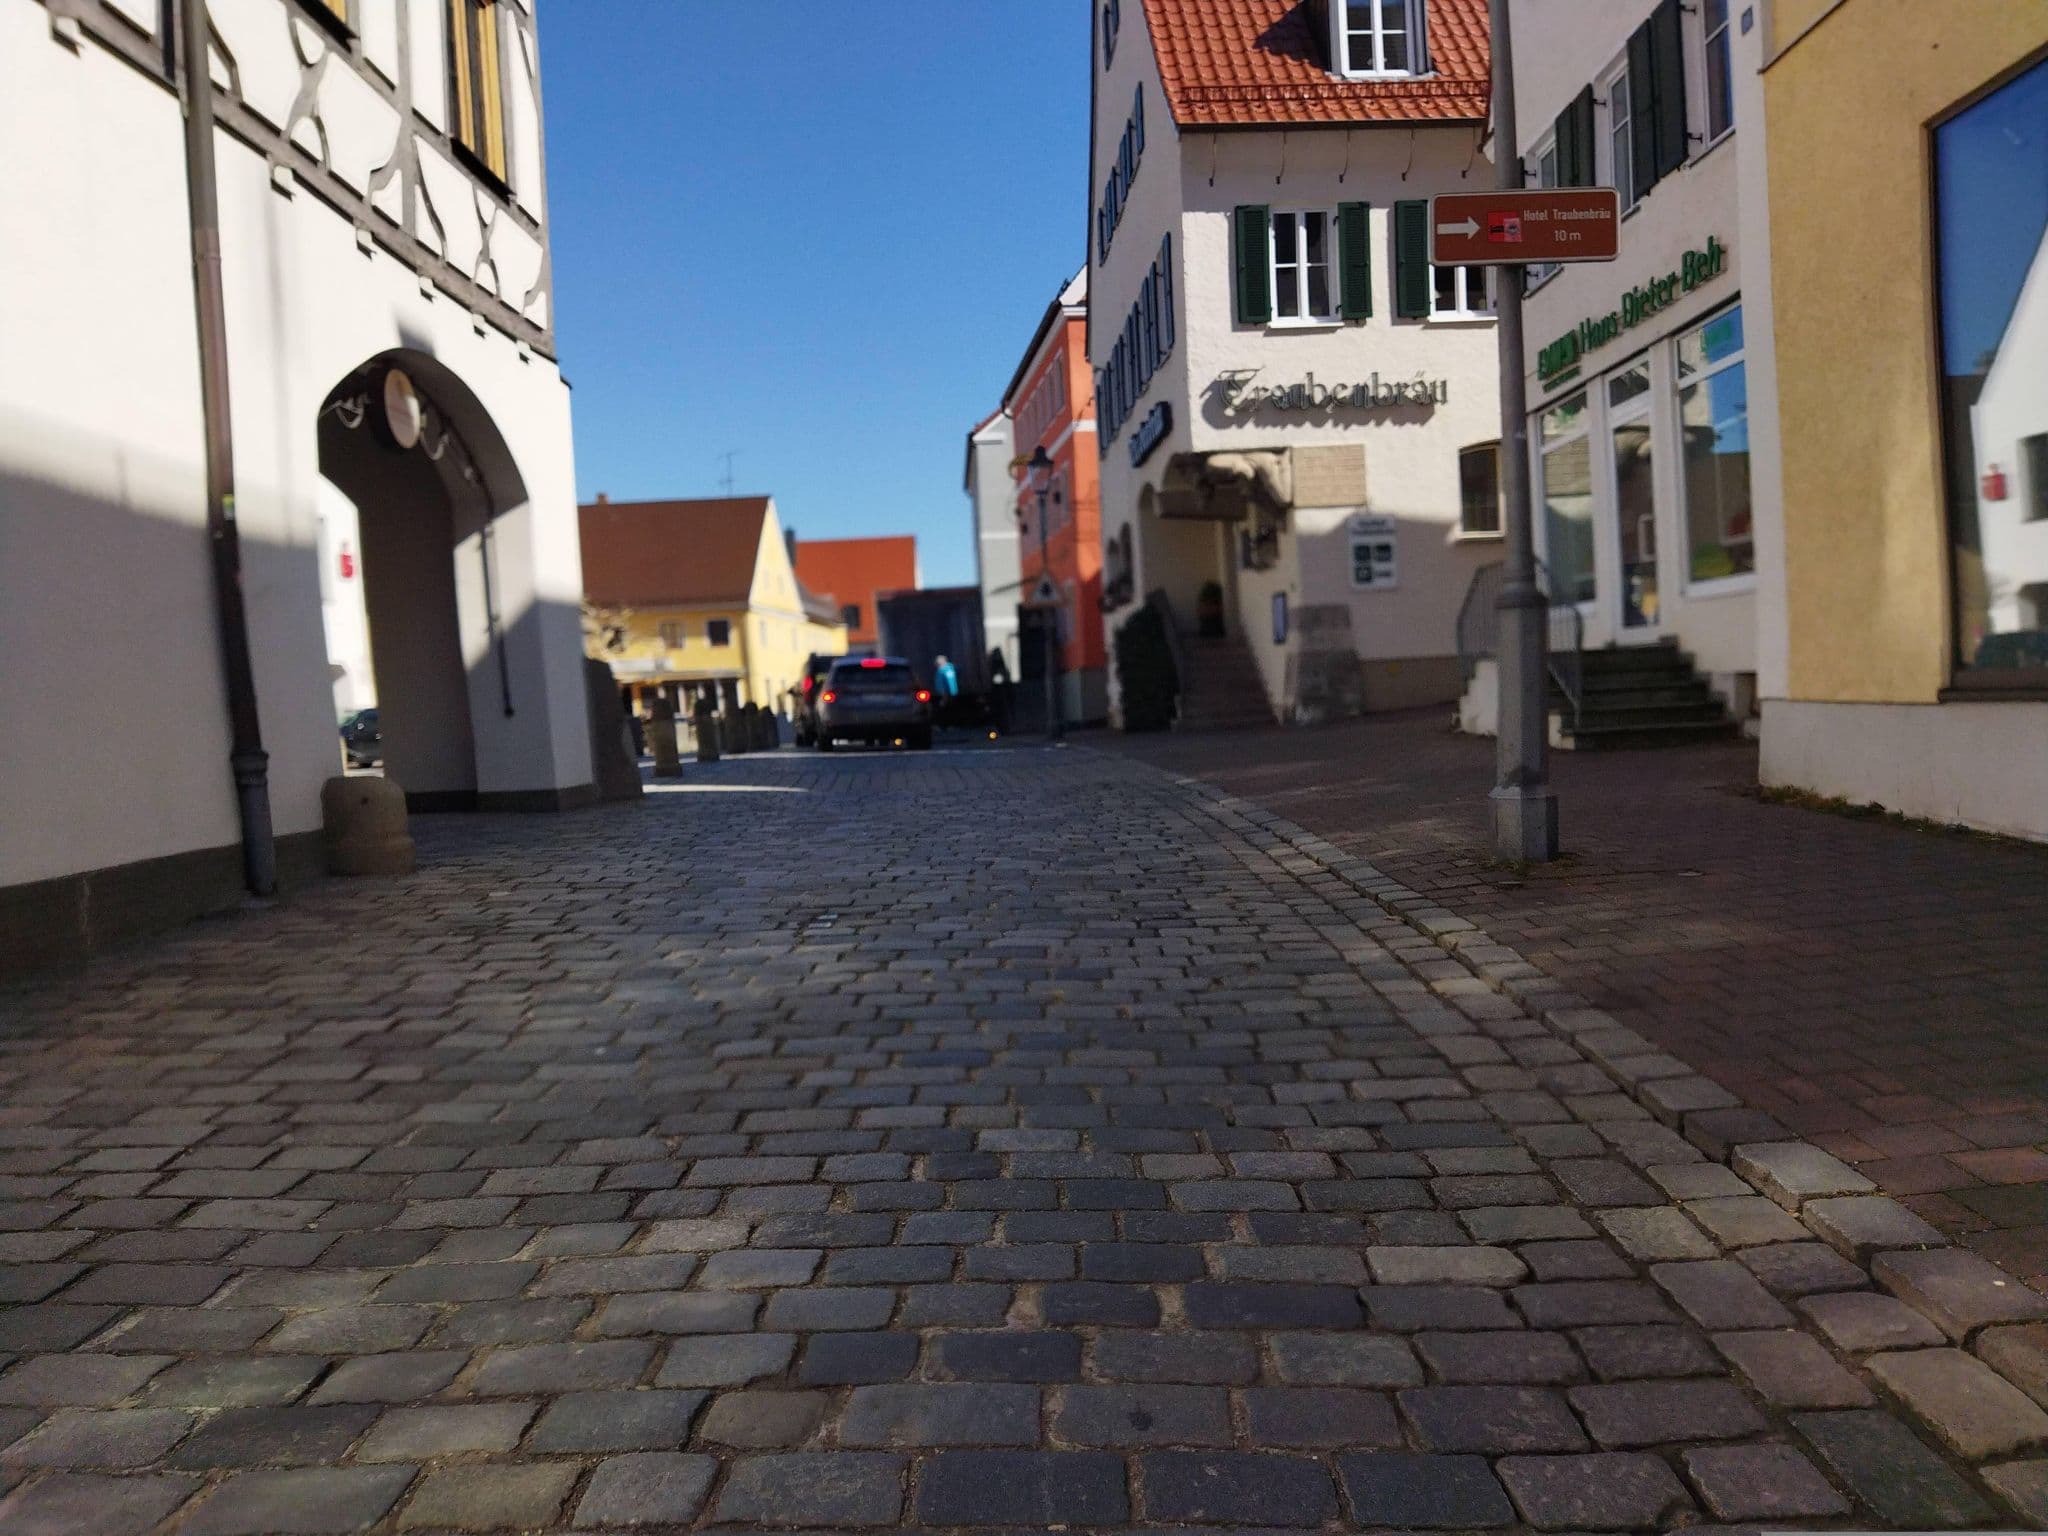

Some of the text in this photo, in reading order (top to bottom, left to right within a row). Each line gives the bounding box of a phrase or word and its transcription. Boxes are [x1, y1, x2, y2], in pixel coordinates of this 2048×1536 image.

[1523, 207, 1611, 221] Hotel Traubenbräu
[1554, 230, 1582, 242] 10 m
[1578, 311, 1618, 353] Hans
[1622, 271, 1676, 328] Dieter
[1218, 366, 1448, 411] Traubenbräu
